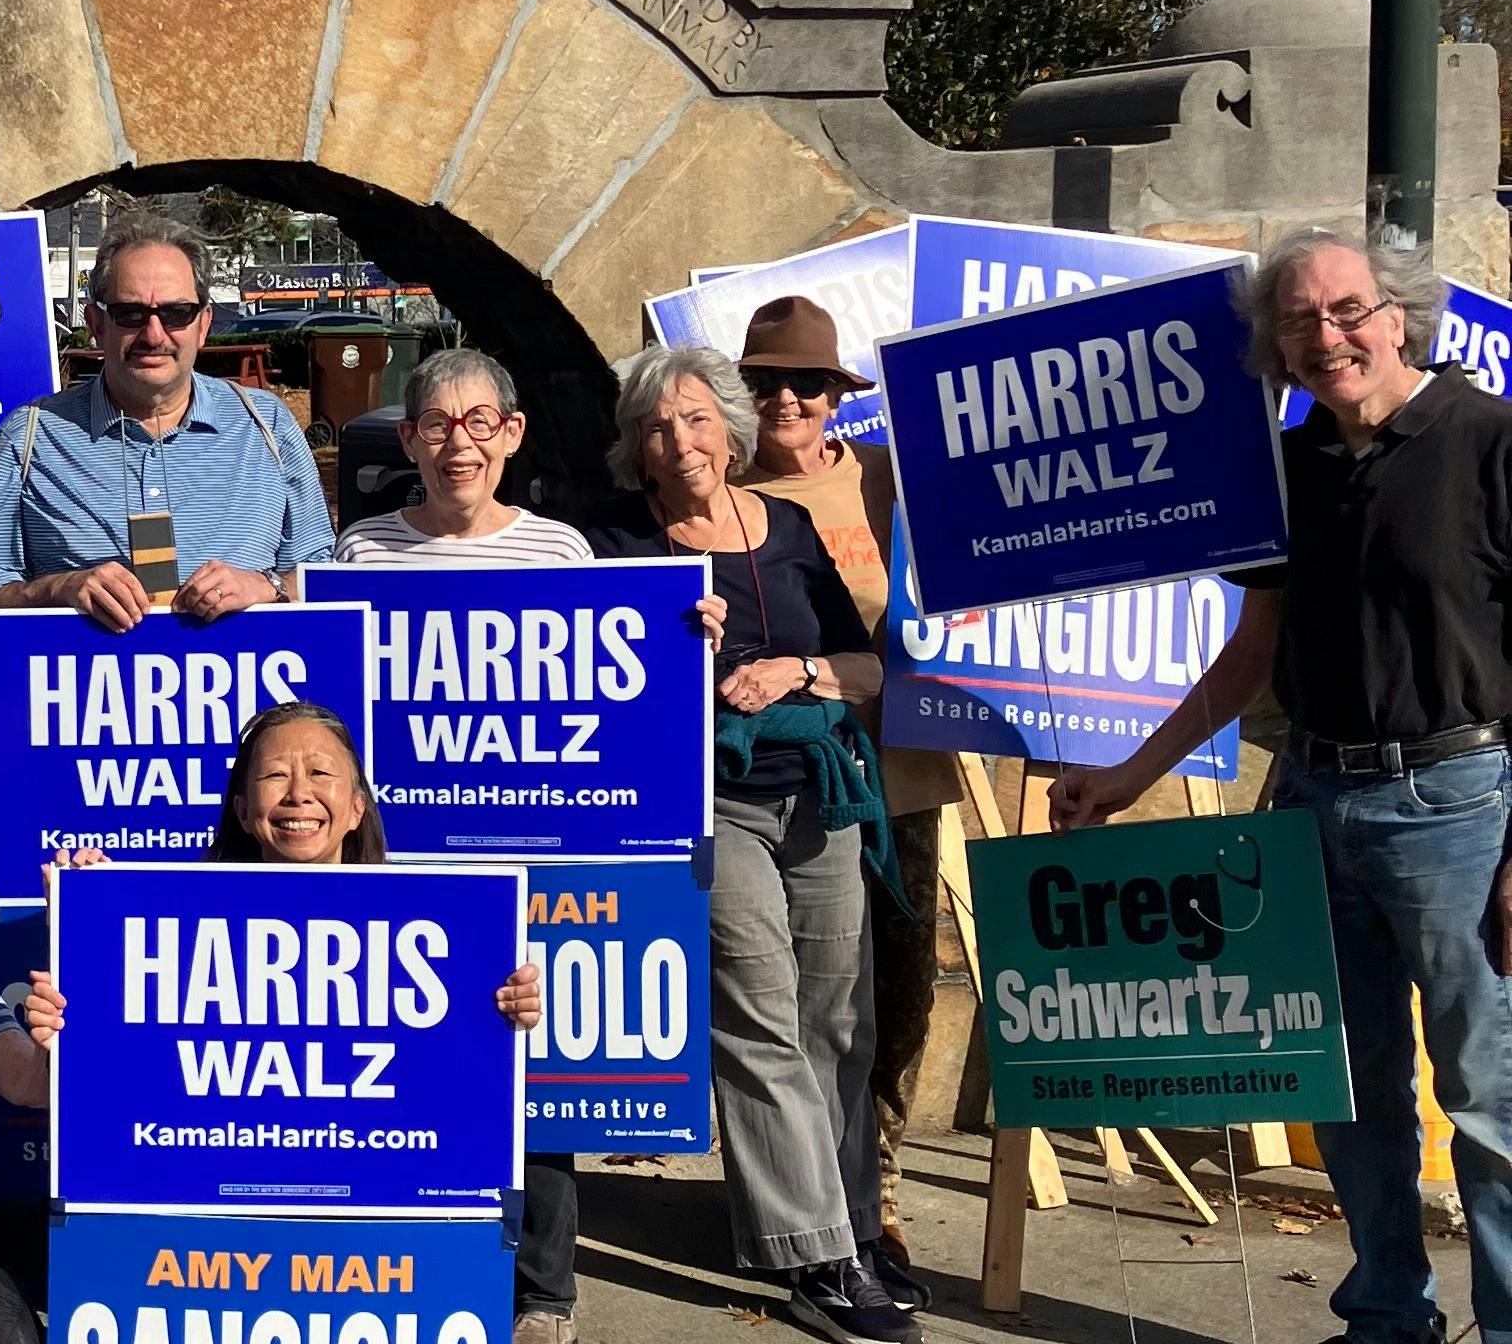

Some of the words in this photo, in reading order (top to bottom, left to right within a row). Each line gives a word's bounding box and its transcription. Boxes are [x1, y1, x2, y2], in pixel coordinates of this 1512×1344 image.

[731, 19, 774, 59] BY
[1434, 310, 1511, 396] RIS
[934, 320, 1205, 459] HARRIS
[994, 432, 1174, 509] WALZ
[971, 496, 1217, 558] KamalaHarris.com
[372, 606, 647, 702] HARRIS
[407, 714, 600, 763] WALZ
[919, 696, 990, 722] State
[1005, 703, 1160, 740] Representa
[76, 757, 236, 806] WAL
[373, 783, 638, 807] KamalaHarris.com
[41, 825, 215, 850] KamalaHarri
[1028, 864, 1226, 962] Greg
[123, 916, 450, 1029] HARRIS
[176, 1039, 396, 1099] WALZ
[1031, 1071, 1095, 1101] State
[1102, 1069, 1300, 1103] Representative
[525, 1097, 667, 1120] sentative
[133, 1120, 438, 1151] KamalaHarris.com
[146, 1248, 272, 1292] AMY
[290, 1254, 415, 1294] MAH
